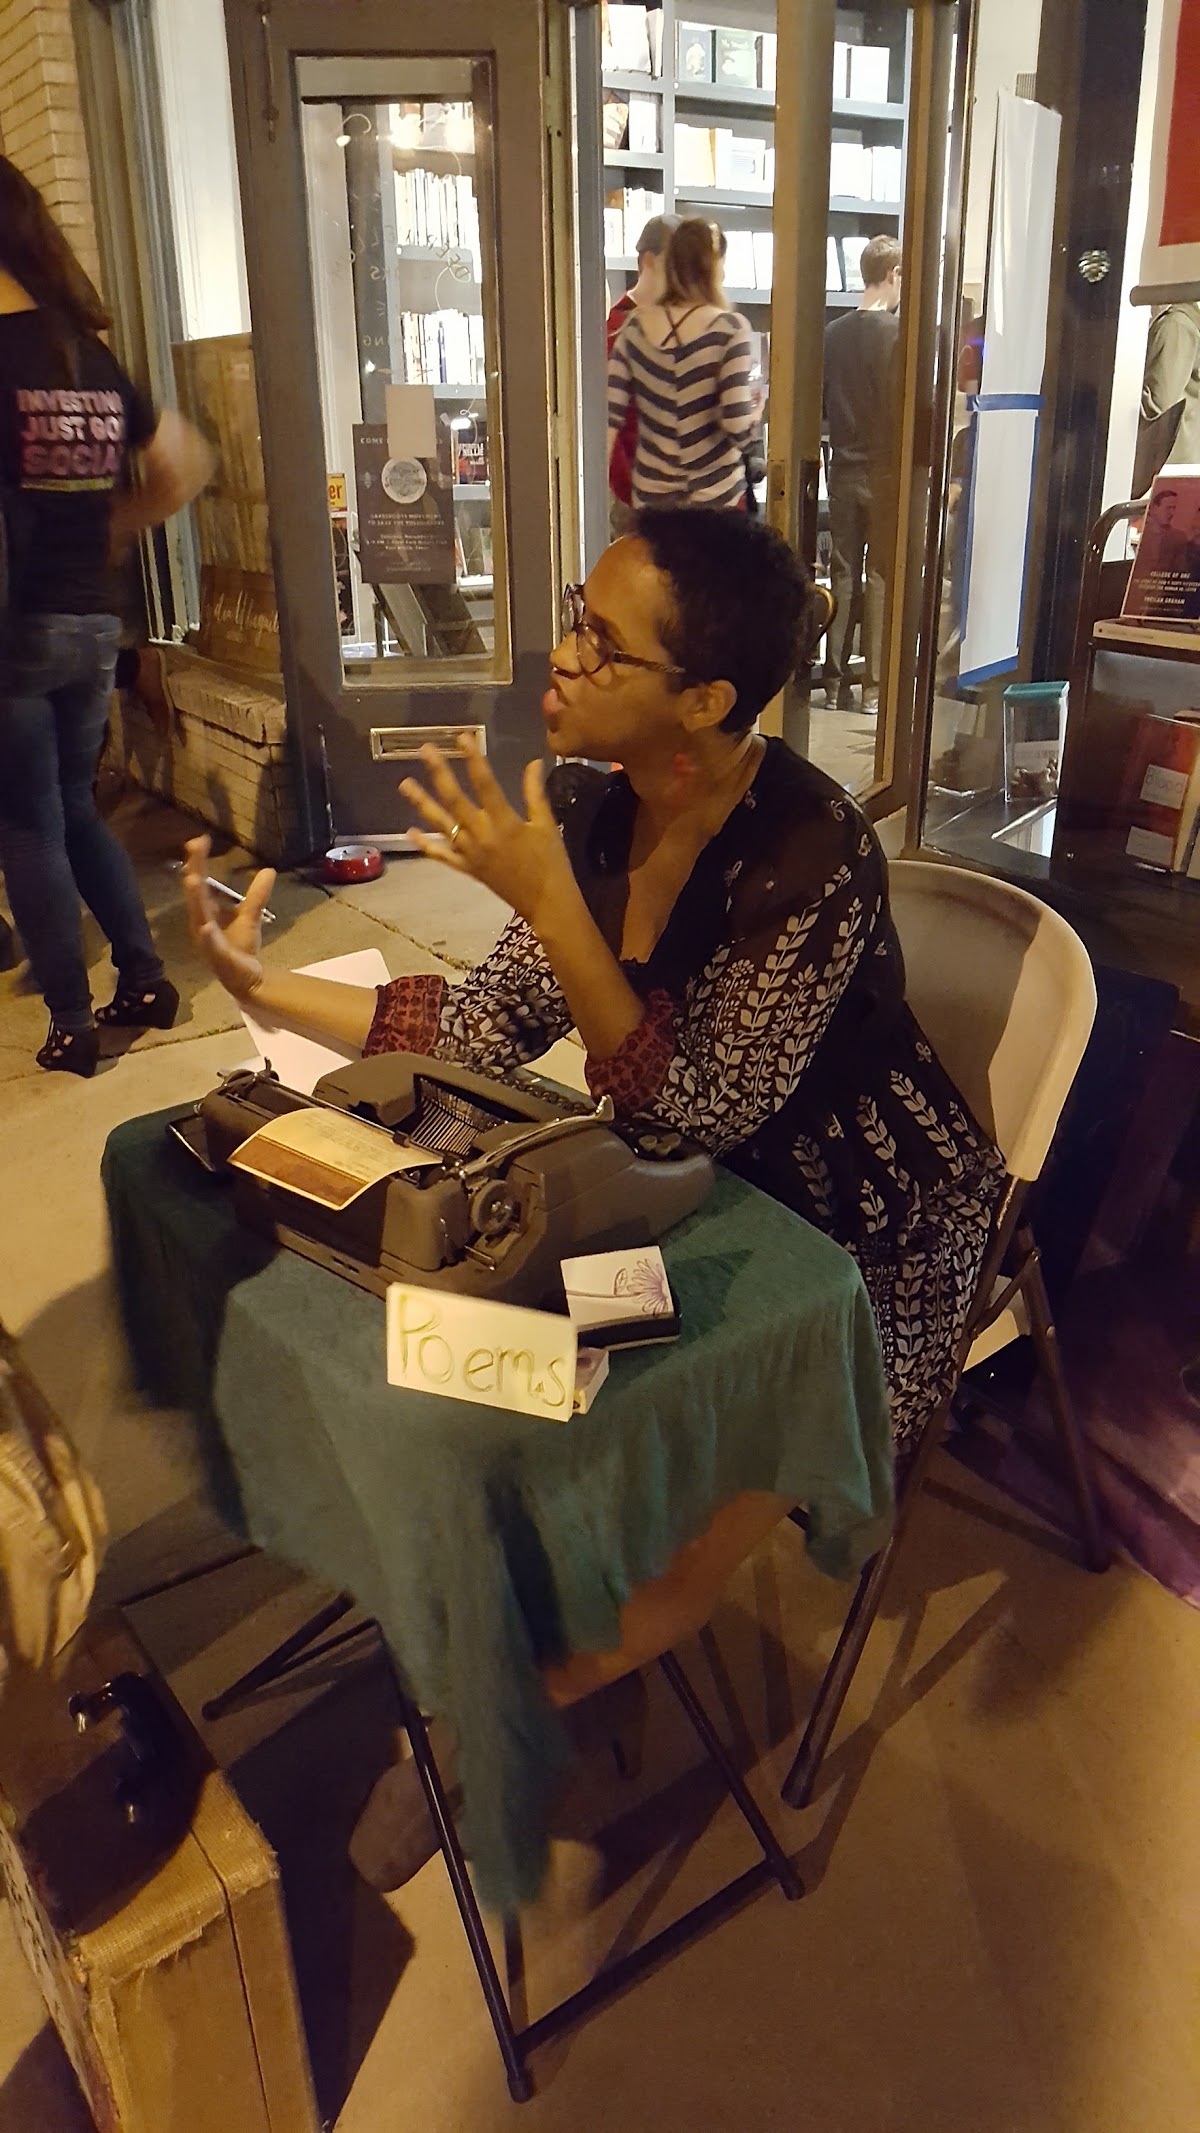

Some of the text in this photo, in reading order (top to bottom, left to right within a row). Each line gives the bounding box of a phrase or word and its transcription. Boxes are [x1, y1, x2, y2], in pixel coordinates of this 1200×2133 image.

[15, 388, 124, 414] INVESTIN
[21, 415, 121, 442] JUST GO
[22, 444, 120, 476] SOCIA
[398, 1292, 567, 1407] Poems
